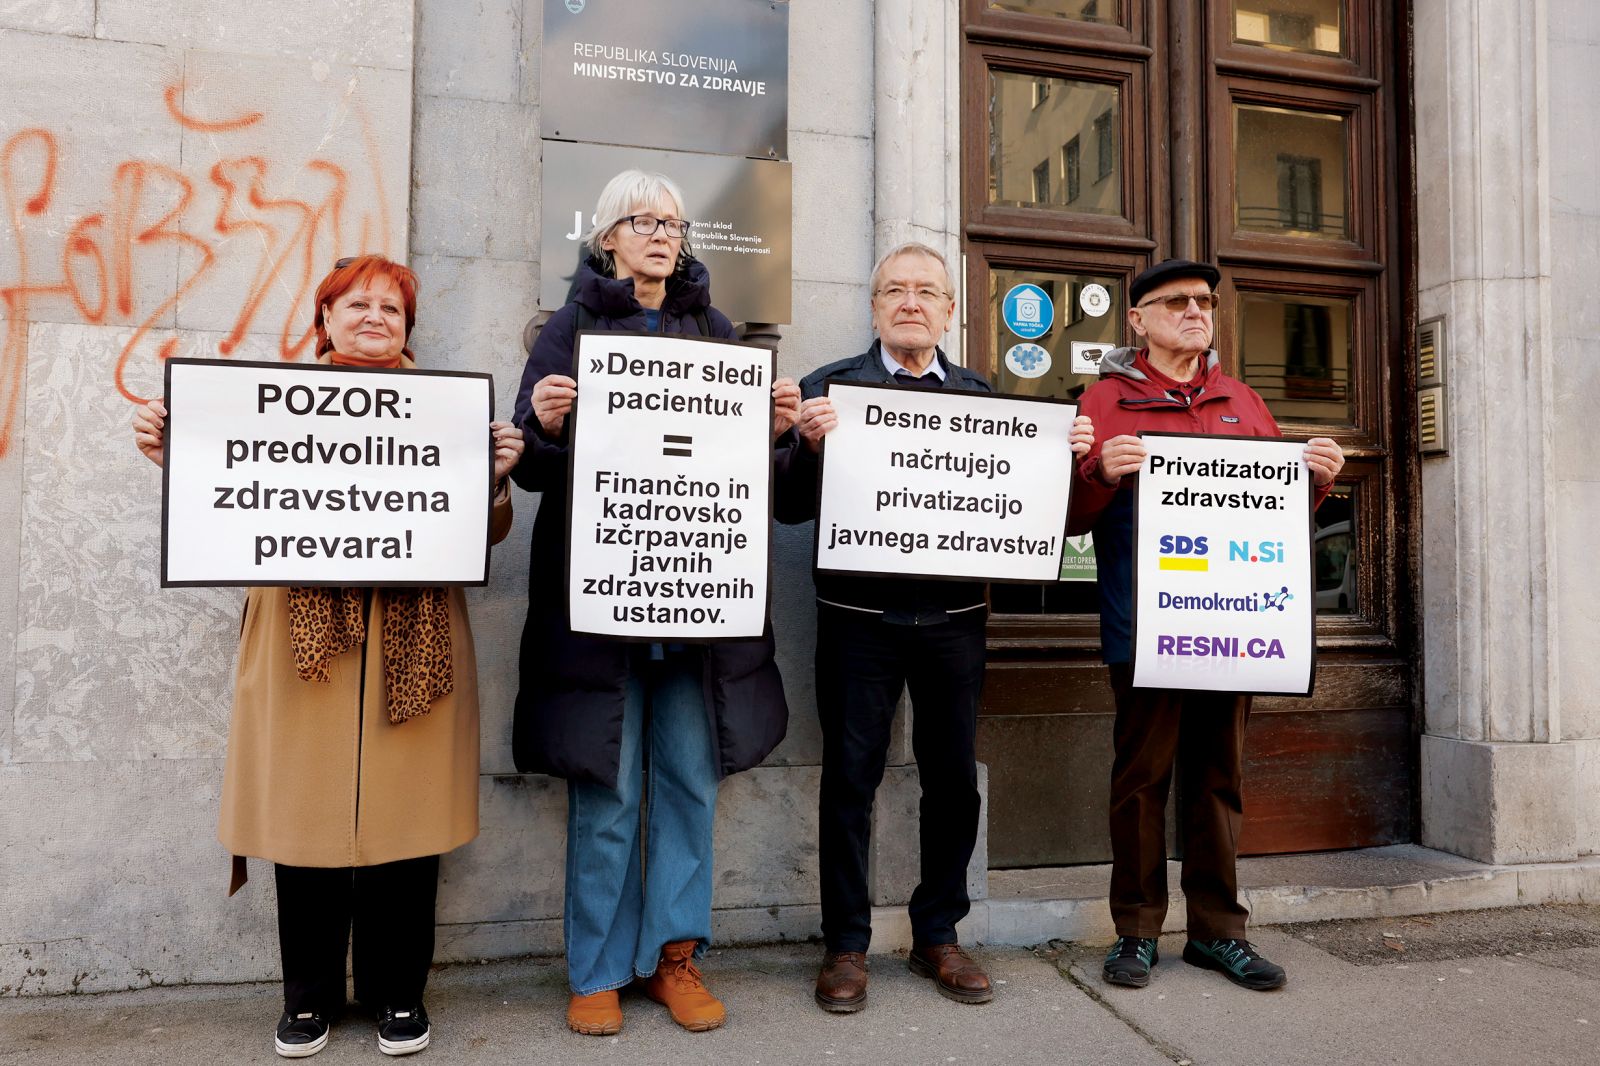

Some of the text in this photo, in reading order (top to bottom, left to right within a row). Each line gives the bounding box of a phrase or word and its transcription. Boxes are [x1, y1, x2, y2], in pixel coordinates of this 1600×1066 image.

[573, 42, 738, 75] REPUBLIKA SLOVENIJA
[573, 62, 766, 97] MINISTRSTVO ZA ZDRAVJE
[691, 220, 733, 230] Javni sklad
[691, 230, 762, 245] Republike Slovenije
[691, 242, 771, 255] za kulturne dejavnosti
[701, 360, 763, 387] sledi
[257, 383, 412, 419] POZOR:
[865, 404, 1038, 439] Desne stranke
[226, 434, 441, 470] predvolilna
[890, 448, 1011, 480] načrtujejo
[595, 470, 750, 500] Finančno in
[1149, 455, 1299, 486] Privatizatorji
[213, 480, 450, 513] zdravstvena
[603, 496, 742, 524] kadrovsko
[876, 486, 1023, 520] privatizacijo
[1161, 486, 1285, 511] zdravstva:
[254, 529, 413, 566] prevara!
[595, 522, 748, 555] izčrpavanje
[827, 522, 1056, 556] javnega zdravstva!
[1159, 534, 1284, 563] SDS N.Si
[628, 549, 712, 577] javnih
[582, 574, 754, 599] zdravstvenih
[1158, 591, 1258, 612] Demokrati
[613, 602, 725, 624] ustanov.
[1157, 635, 1286, 659] RESNI.CA
